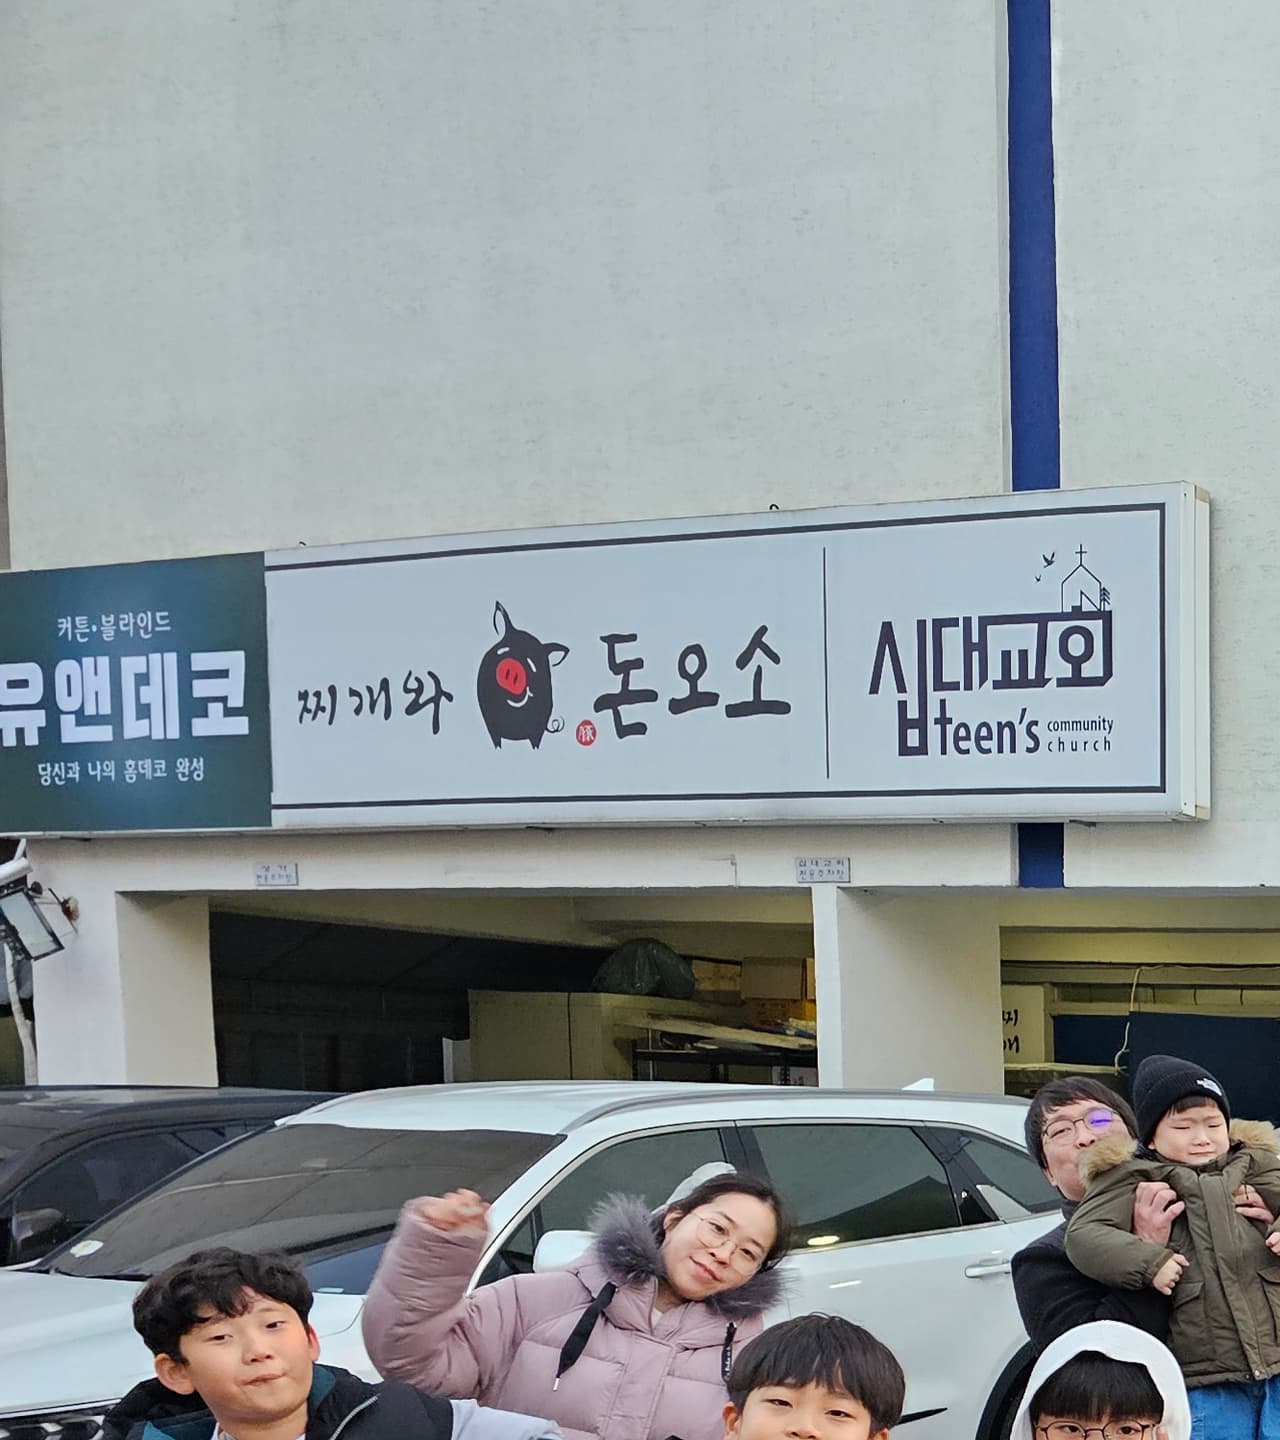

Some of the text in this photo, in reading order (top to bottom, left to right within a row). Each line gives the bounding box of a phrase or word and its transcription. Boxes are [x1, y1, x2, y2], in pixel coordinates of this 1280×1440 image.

[0, 650, 250, 747] 유앤데코
[297, 624, 792, 739] 찌개와 돈오소
[868, 610, 1114, 757] 십대교회
[934, 698, 1040, 757] teen's
[1047, 715, 1115, 736] community
[1047, 736, 1113, 753] church
[38, 757, 205, 785] 당신과 나의 홈데코 완성
